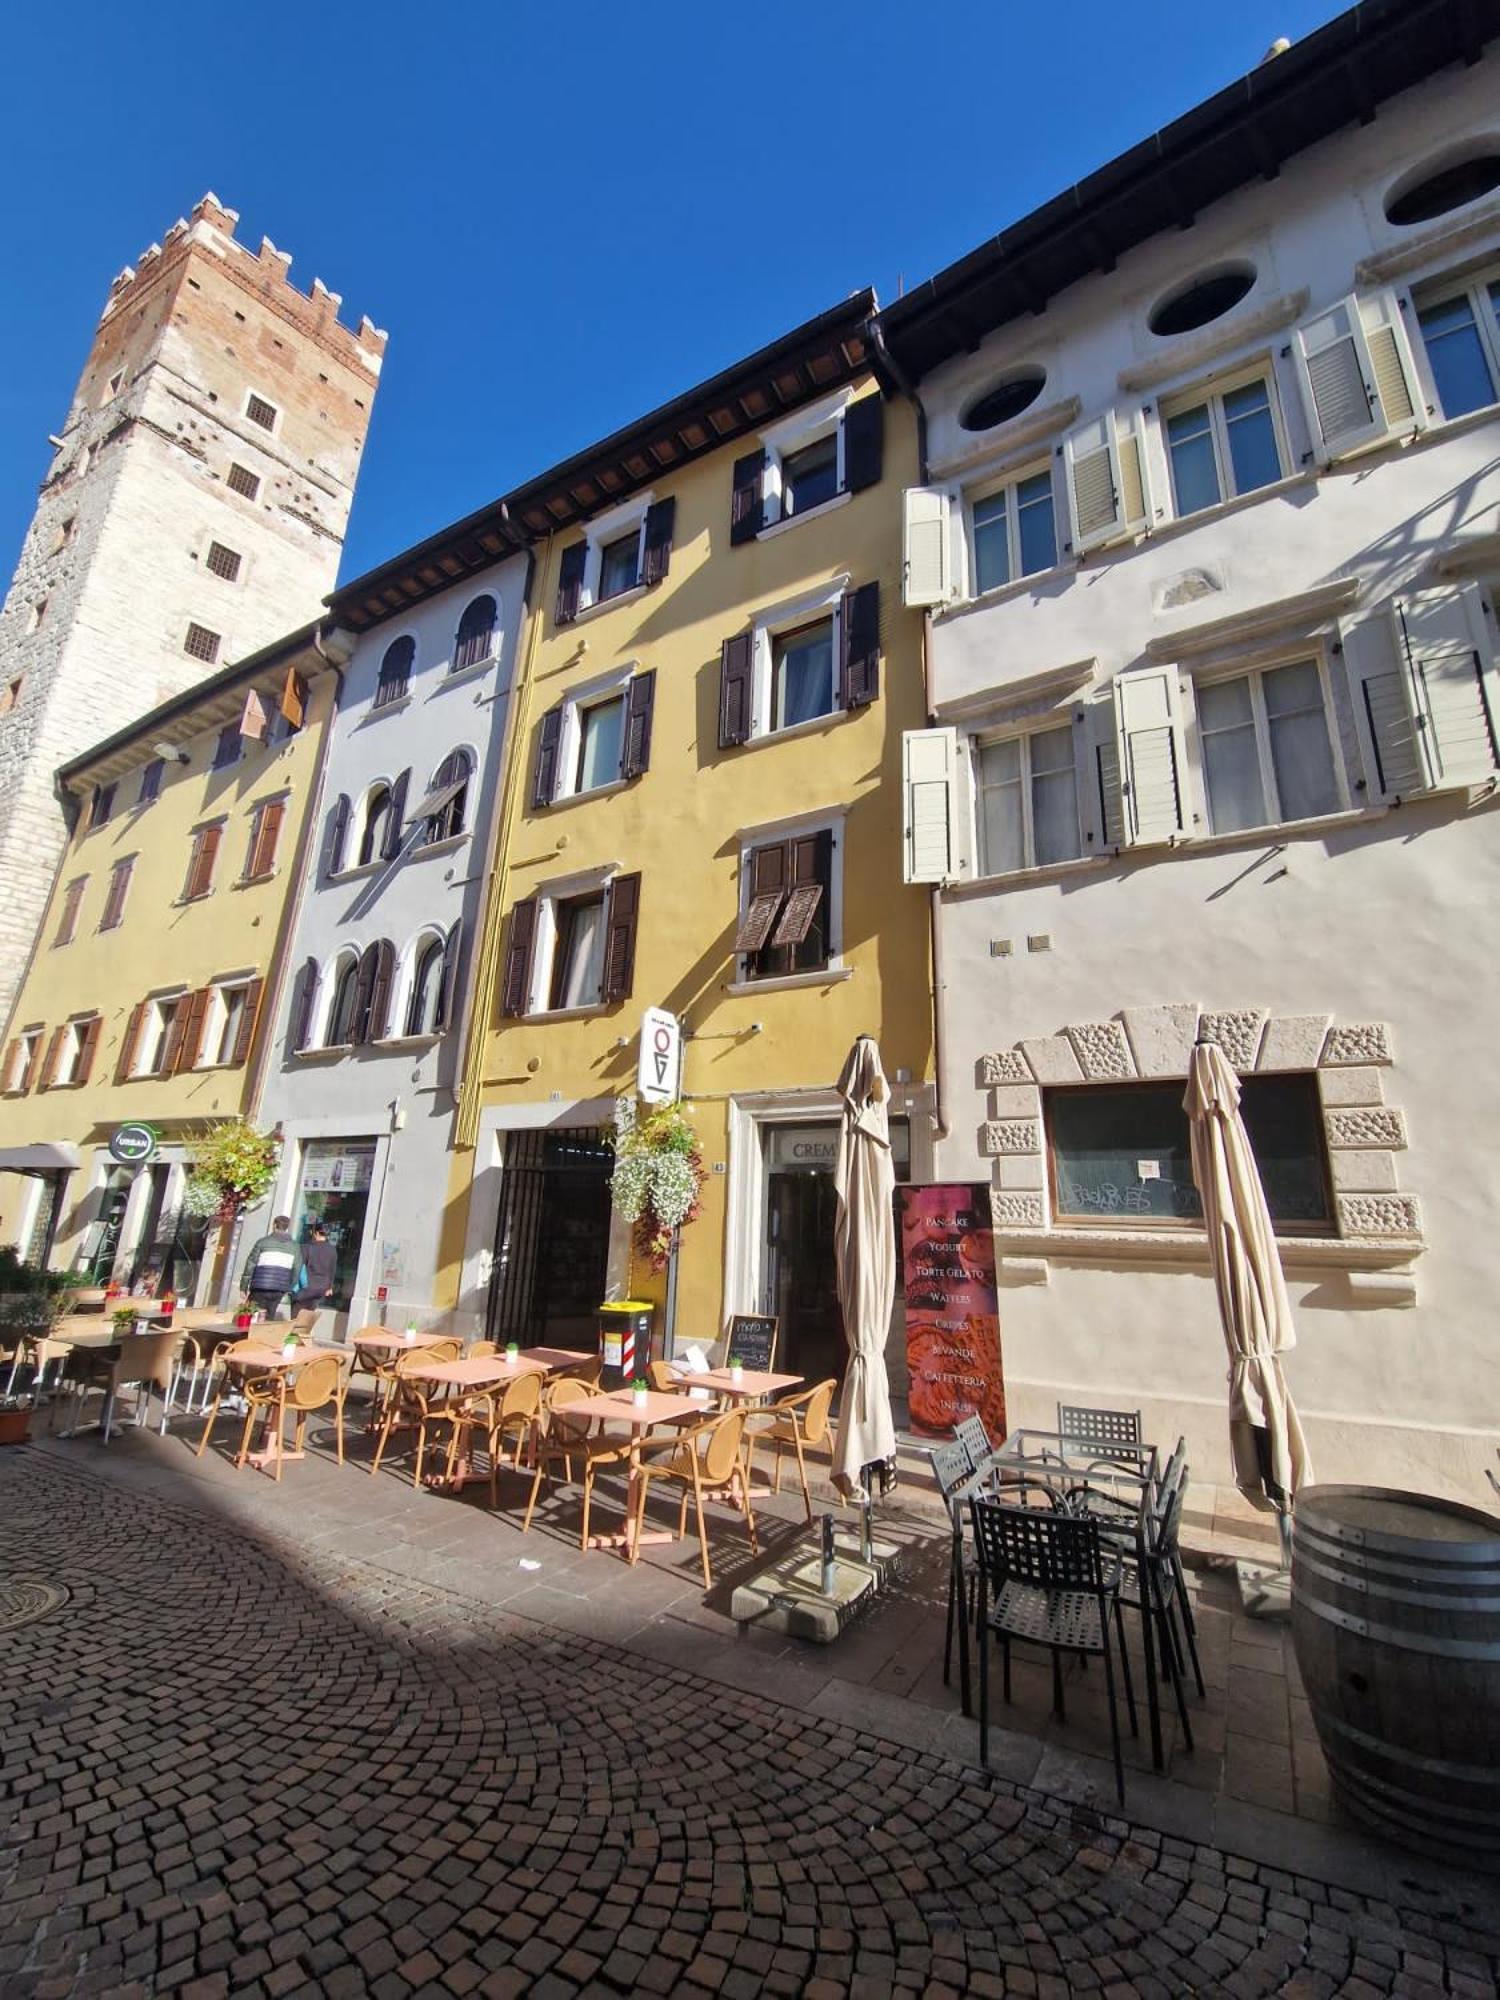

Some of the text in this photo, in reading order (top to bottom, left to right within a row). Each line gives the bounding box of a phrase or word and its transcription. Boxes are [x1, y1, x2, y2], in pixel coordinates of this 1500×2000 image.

[926, 1217, 969, 1227] PANCAKE
[928, 1241, 968, 1252] YOGURT
[915, 1266, 985, 1279] TORTE GELATO
[930, 1292, 971, 1303] WAFFLES
